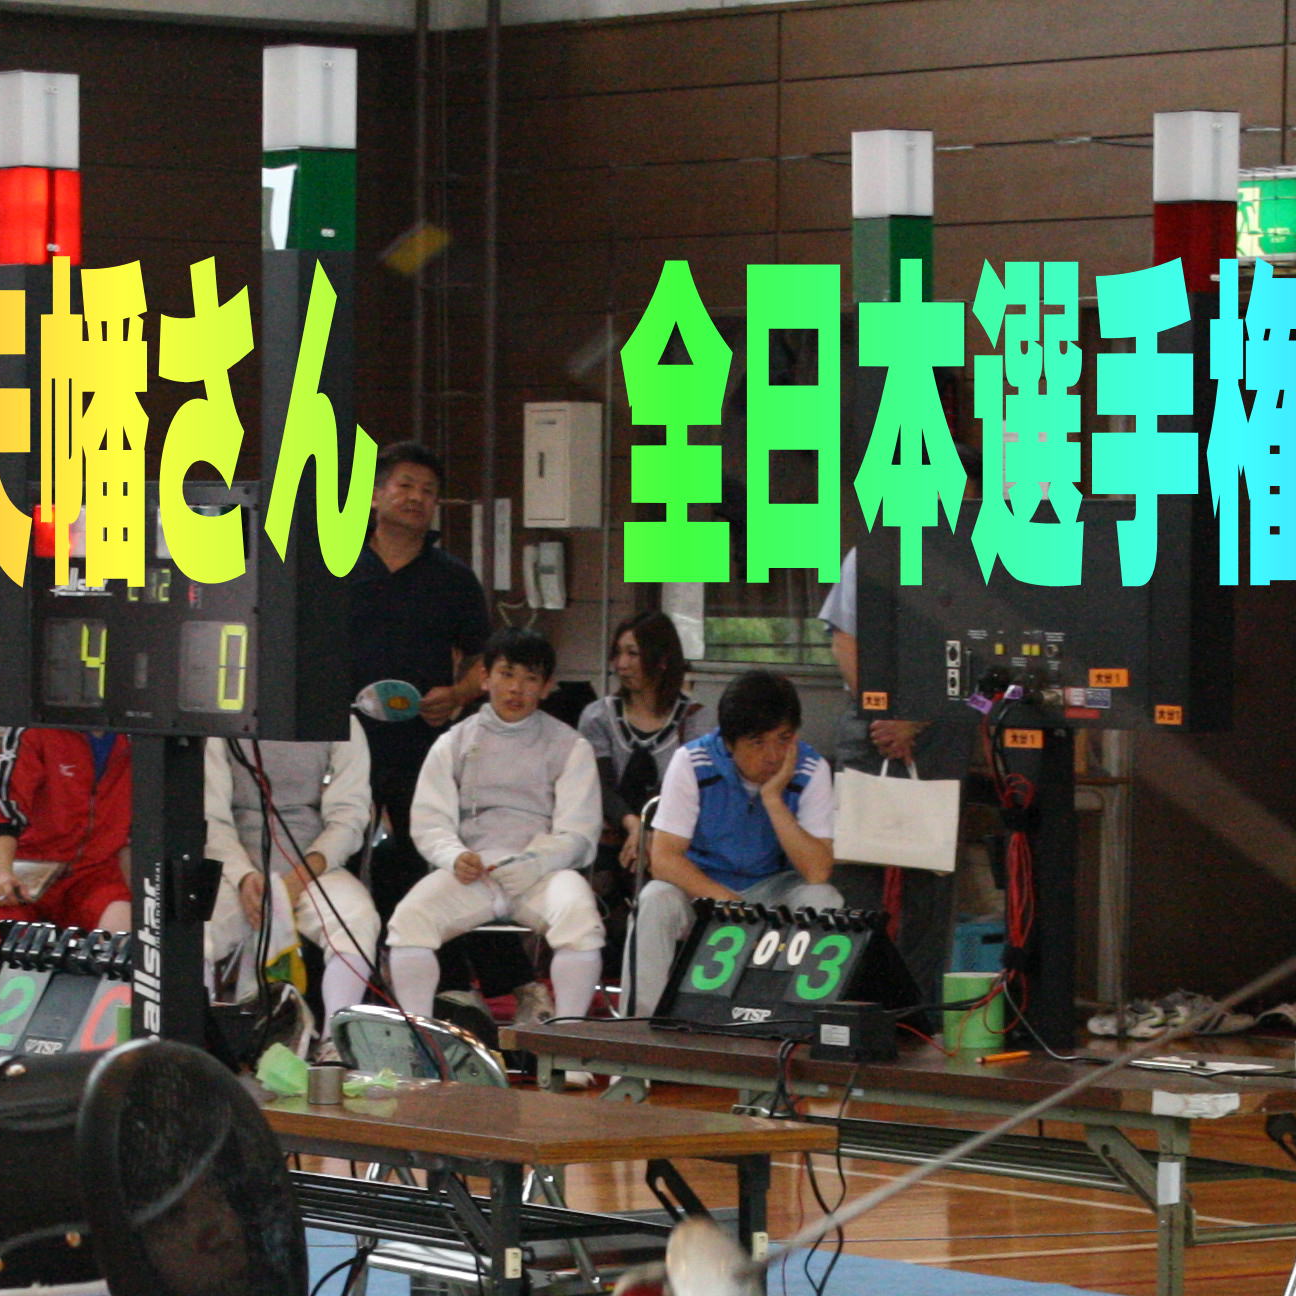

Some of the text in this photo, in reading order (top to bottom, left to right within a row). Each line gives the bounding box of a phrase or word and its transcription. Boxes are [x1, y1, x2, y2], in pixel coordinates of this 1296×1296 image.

[80, 623, 108, 699] 4
[217, 624, 248, 711] 0
[134, 877, 161, 1033] allstar
[691, 926, 852, 1000] 3 0 0 3
